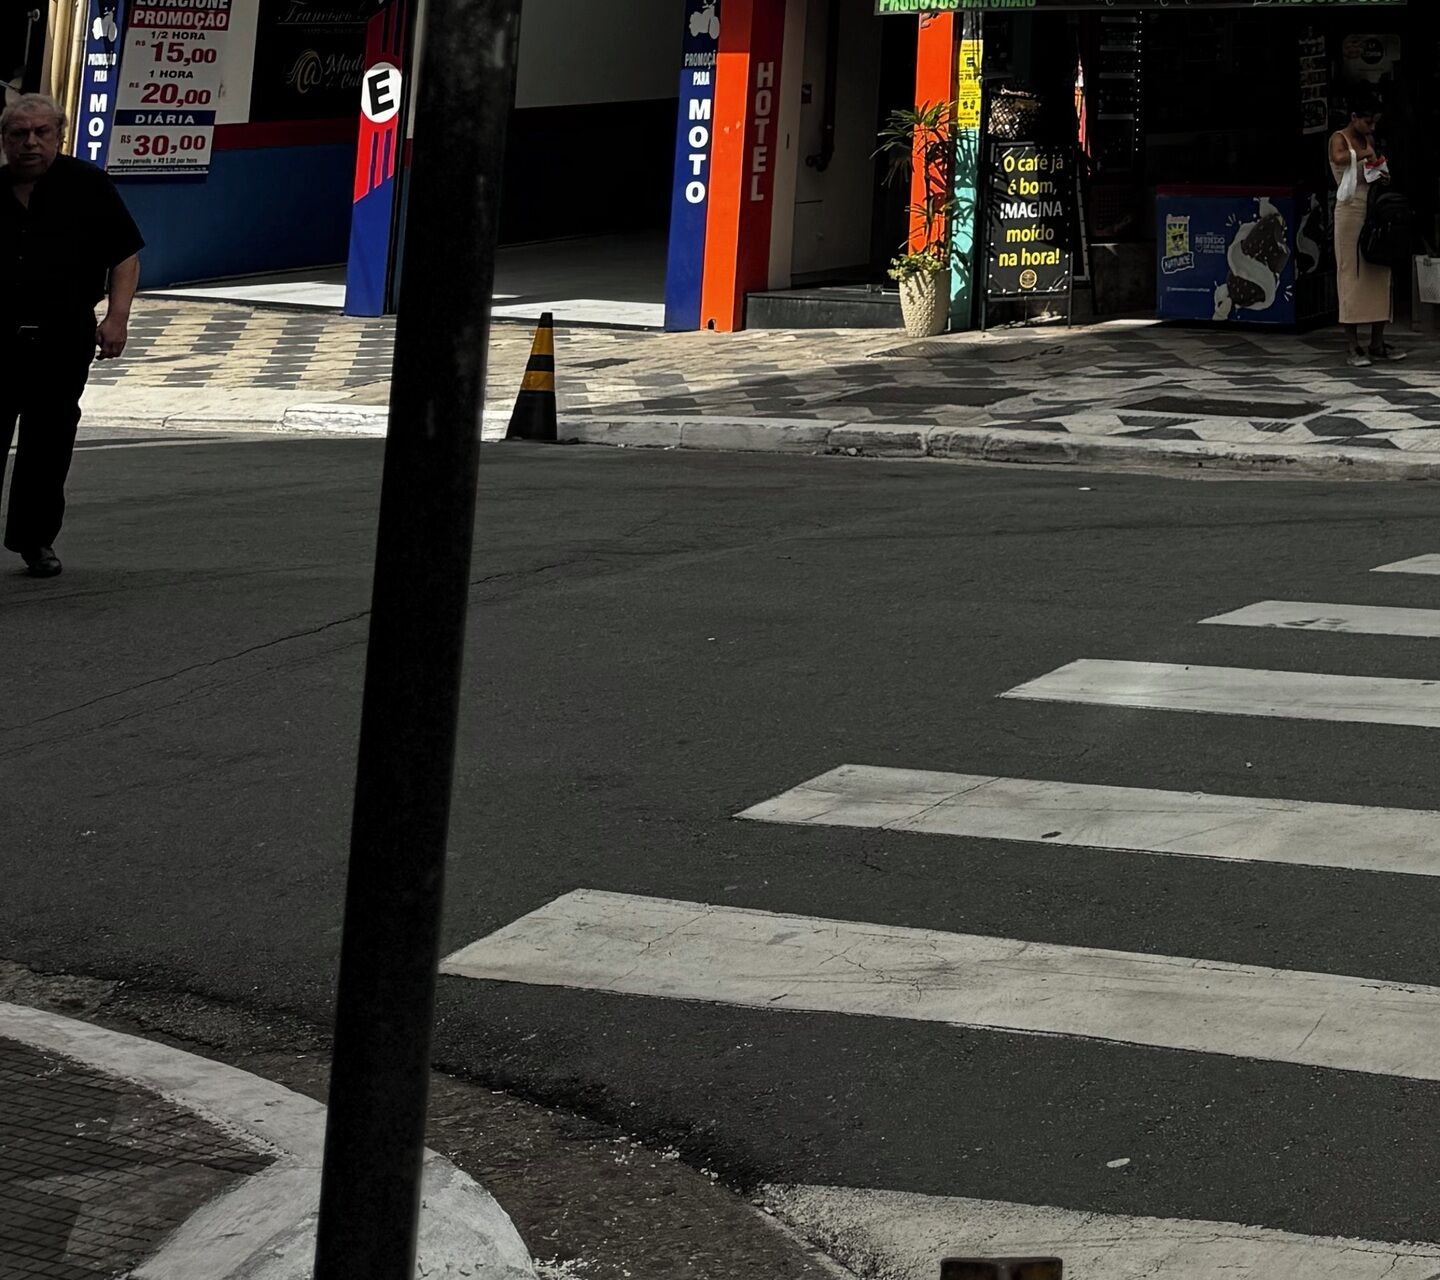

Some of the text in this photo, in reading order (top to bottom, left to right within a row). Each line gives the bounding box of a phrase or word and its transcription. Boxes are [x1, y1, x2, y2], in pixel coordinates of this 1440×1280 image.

[133, 10, 228, 29] PROMOÇÃO
[151, 31, 205, 40] 1/2 HORA
[151, 42, 217, 66] 15,00
[160, 70, 194, 79] HORA
[141, 83, 211, 107] 20,00
[87, 94, 108, 161] MOT
[134, 111, 196, 125] DIÁRIA
[750, 61, 774, 202] HOTEL
[133, 135, 206, 156] 30,00
[685, 99, 711, 204] MOTO
[1003, 153, 1064, 174] O café já
[1007, 177, 1058, 196] é bom,
[1000, 200, 1063, 220] IMAGINA
[1006, 223, 1055, 243] moído
[998, 247, 1060, 267] na hora!
